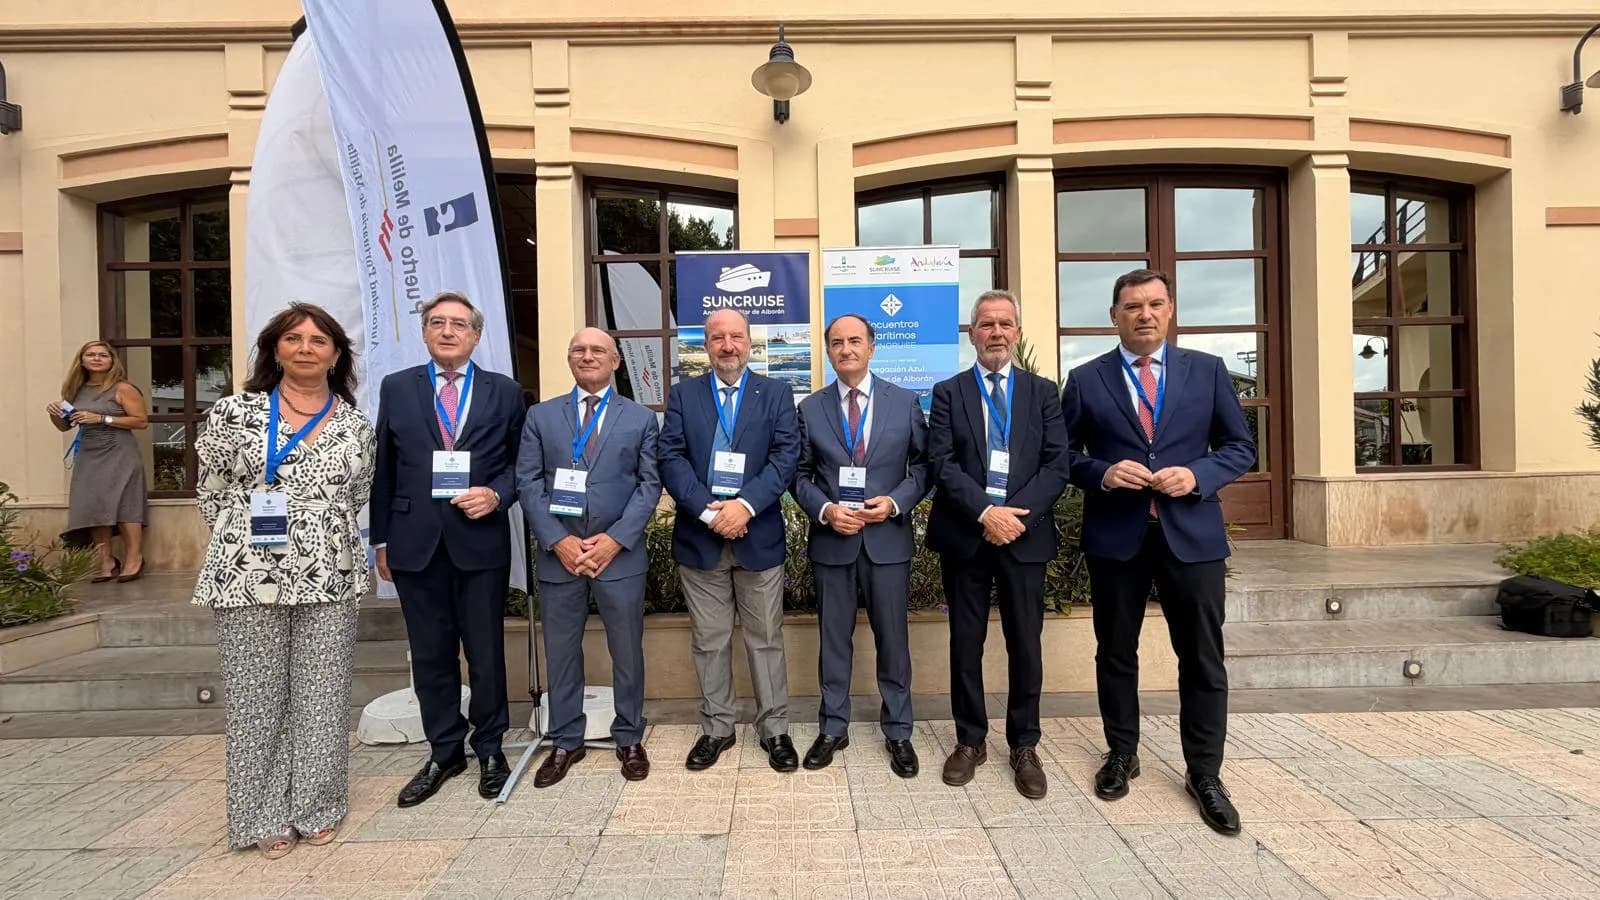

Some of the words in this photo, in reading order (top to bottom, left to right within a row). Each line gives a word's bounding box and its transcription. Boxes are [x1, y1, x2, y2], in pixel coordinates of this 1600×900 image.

[703, 295, 784, 307] SUNCRUISE
[868, 320, 919, 329] ncuentros
[874, 331, 916, 340] arítimos
